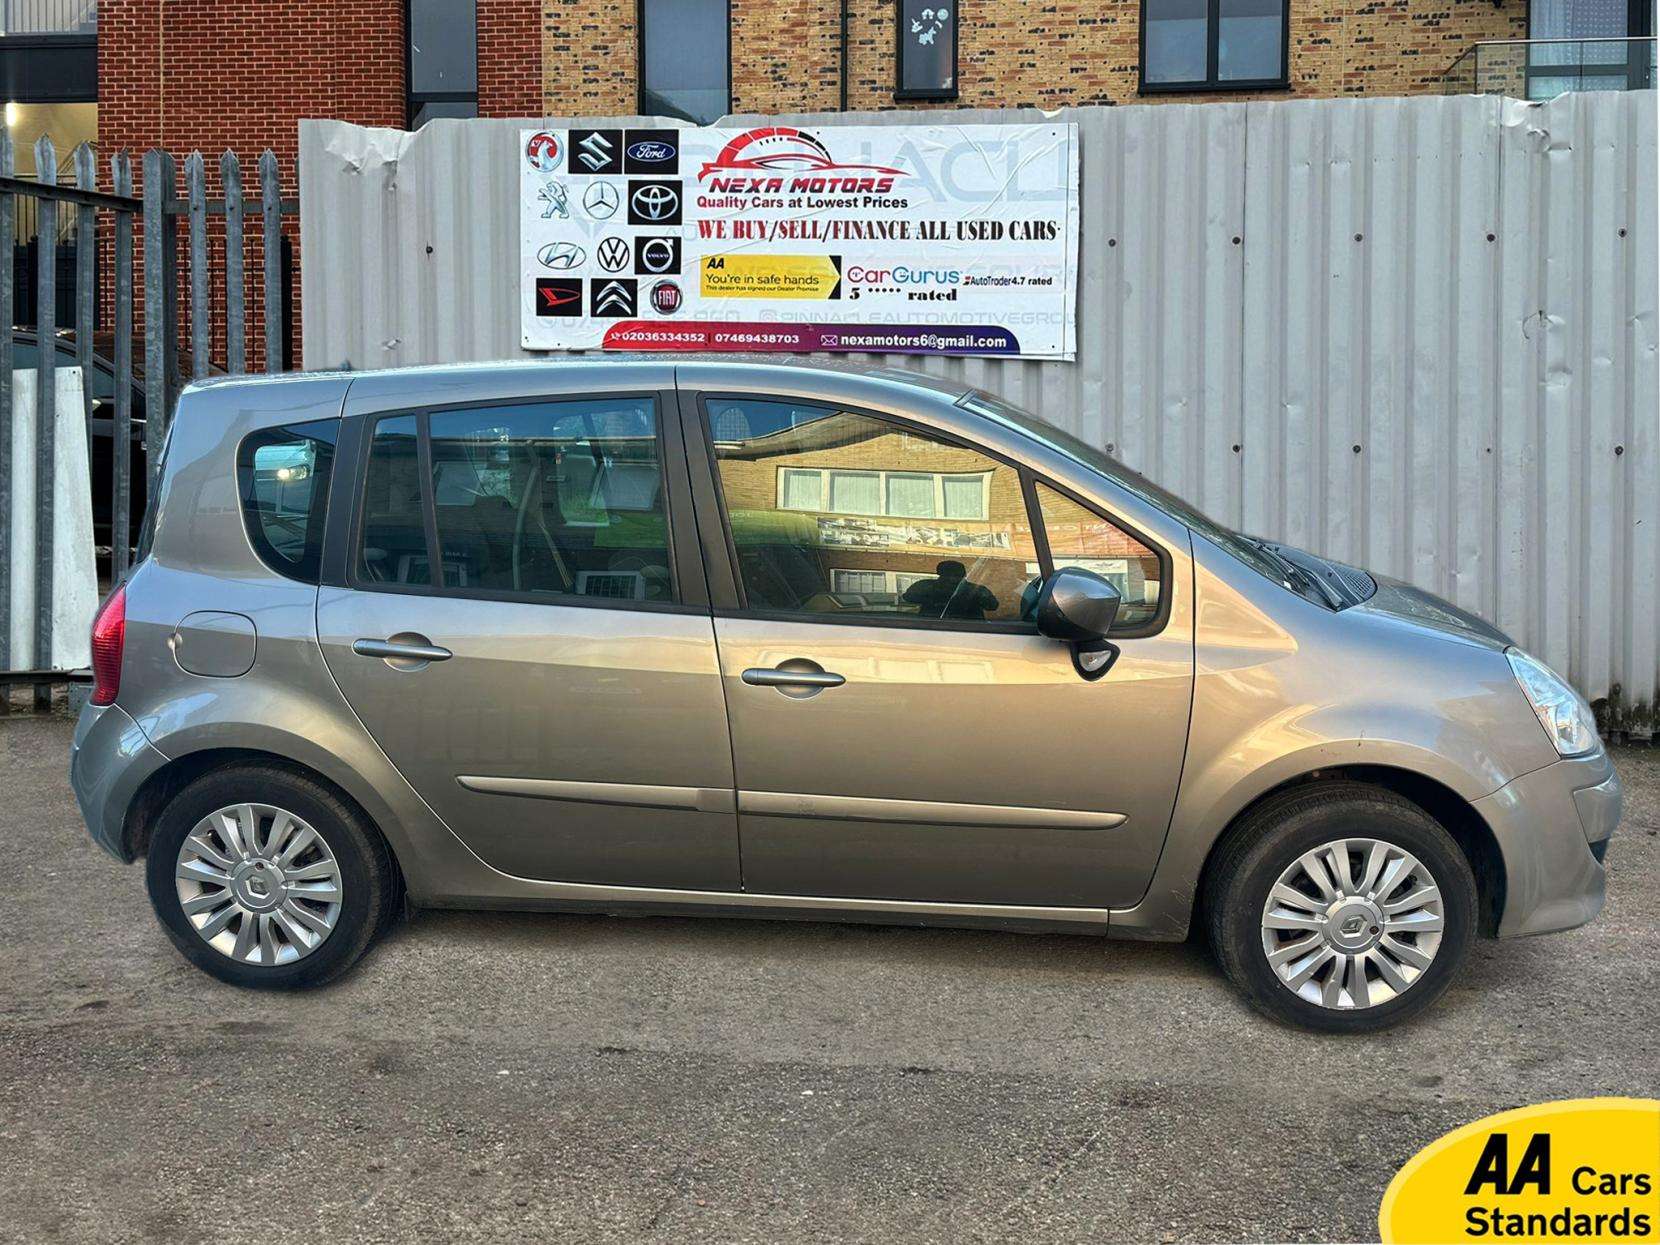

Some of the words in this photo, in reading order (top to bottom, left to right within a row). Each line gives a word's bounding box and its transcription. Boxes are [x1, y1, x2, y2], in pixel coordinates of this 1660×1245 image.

[636, 143, 666, 158] Ford
[709, 178, 784, 193] NEXA
[789, 177, 894, 193] MOTORS
[697, 196, 747, 210] Quality
[752, 196, 784, 208] Cars
[788, 197, 802, 208] at
[807, 196, 858, 208] Lowest
[863, 196, 908, 208] Prices
[697, 220, 727, 240] WE
[916, 220, 950, 240] ALL
[956, 220, 1004, 240] USED
[1008, 220, 1057, 240] CARS
[707, 258, 725, 269] AA
[706, 273, 741, 284] You're
[744, 273, 755, 284] in
[757, 274, 781, 285] safe
[784, 275, 819, 285] hands
[847, 266, 960, 283] CarGurus
[1028, 277, 1052, 286] rated
[658, 289, 677, 305] FIAT
[849, 287, 860, 300] 5
[908, 288, 957, 301] rated
[622, 332, 705, 342] 02036334352
[715, 333, 800, 343] 07469438703
[841, 334, 1007, 349] nexamotors6@gmail.com
